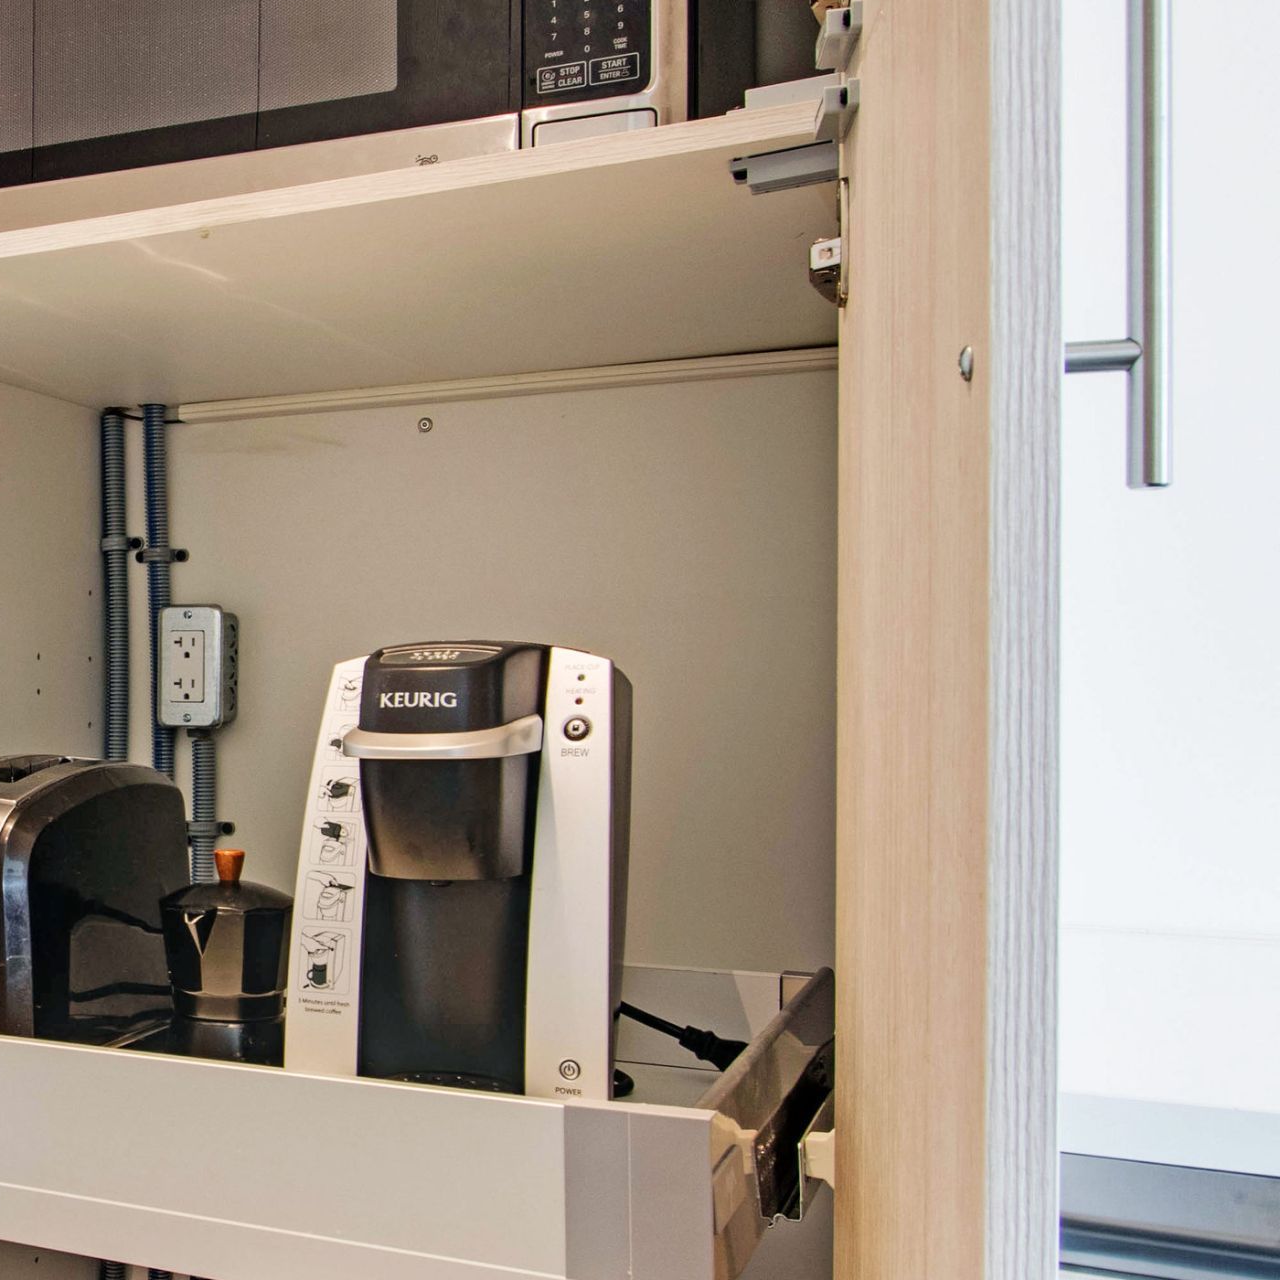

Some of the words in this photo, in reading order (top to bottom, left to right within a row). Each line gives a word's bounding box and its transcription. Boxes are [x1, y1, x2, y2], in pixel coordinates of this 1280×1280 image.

[617, 4, 623, 13] 6
[602, 58, 627, 69] START
[560, 66, 580, 76] STOP
[600, 70, 620, 80] ENTER
[558, 77, 582, 86] CLEAR
[380, 692, 457, 708] KEURIG
[561, 748, 589, 757] BREW
[555, 1087, 581, 1095] POWER
